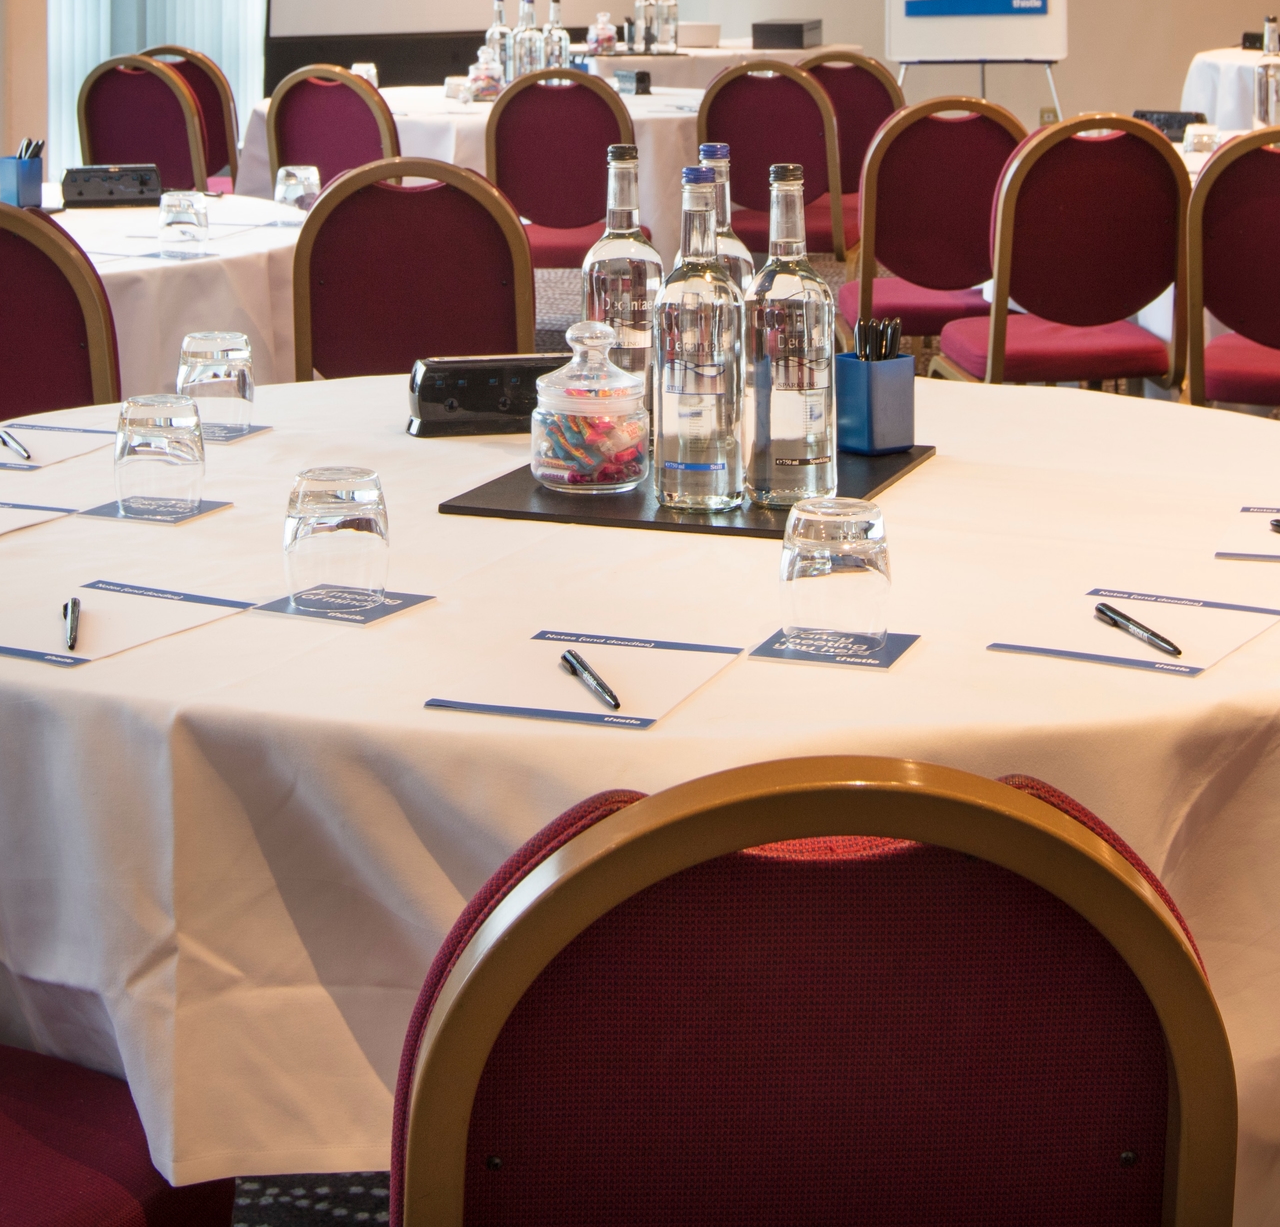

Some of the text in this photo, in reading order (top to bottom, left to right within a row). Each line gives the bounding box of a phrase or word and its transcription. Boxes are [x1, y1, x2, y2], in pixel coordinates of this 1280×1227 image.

[809, 457, 830, 465] Sparkling
[1098, 590, 1129, 598] Notes
[606, 639, 655, 648] doodles)
[835, 656, 880, 664] thistle
[603, 716, 641, 724] thistle
